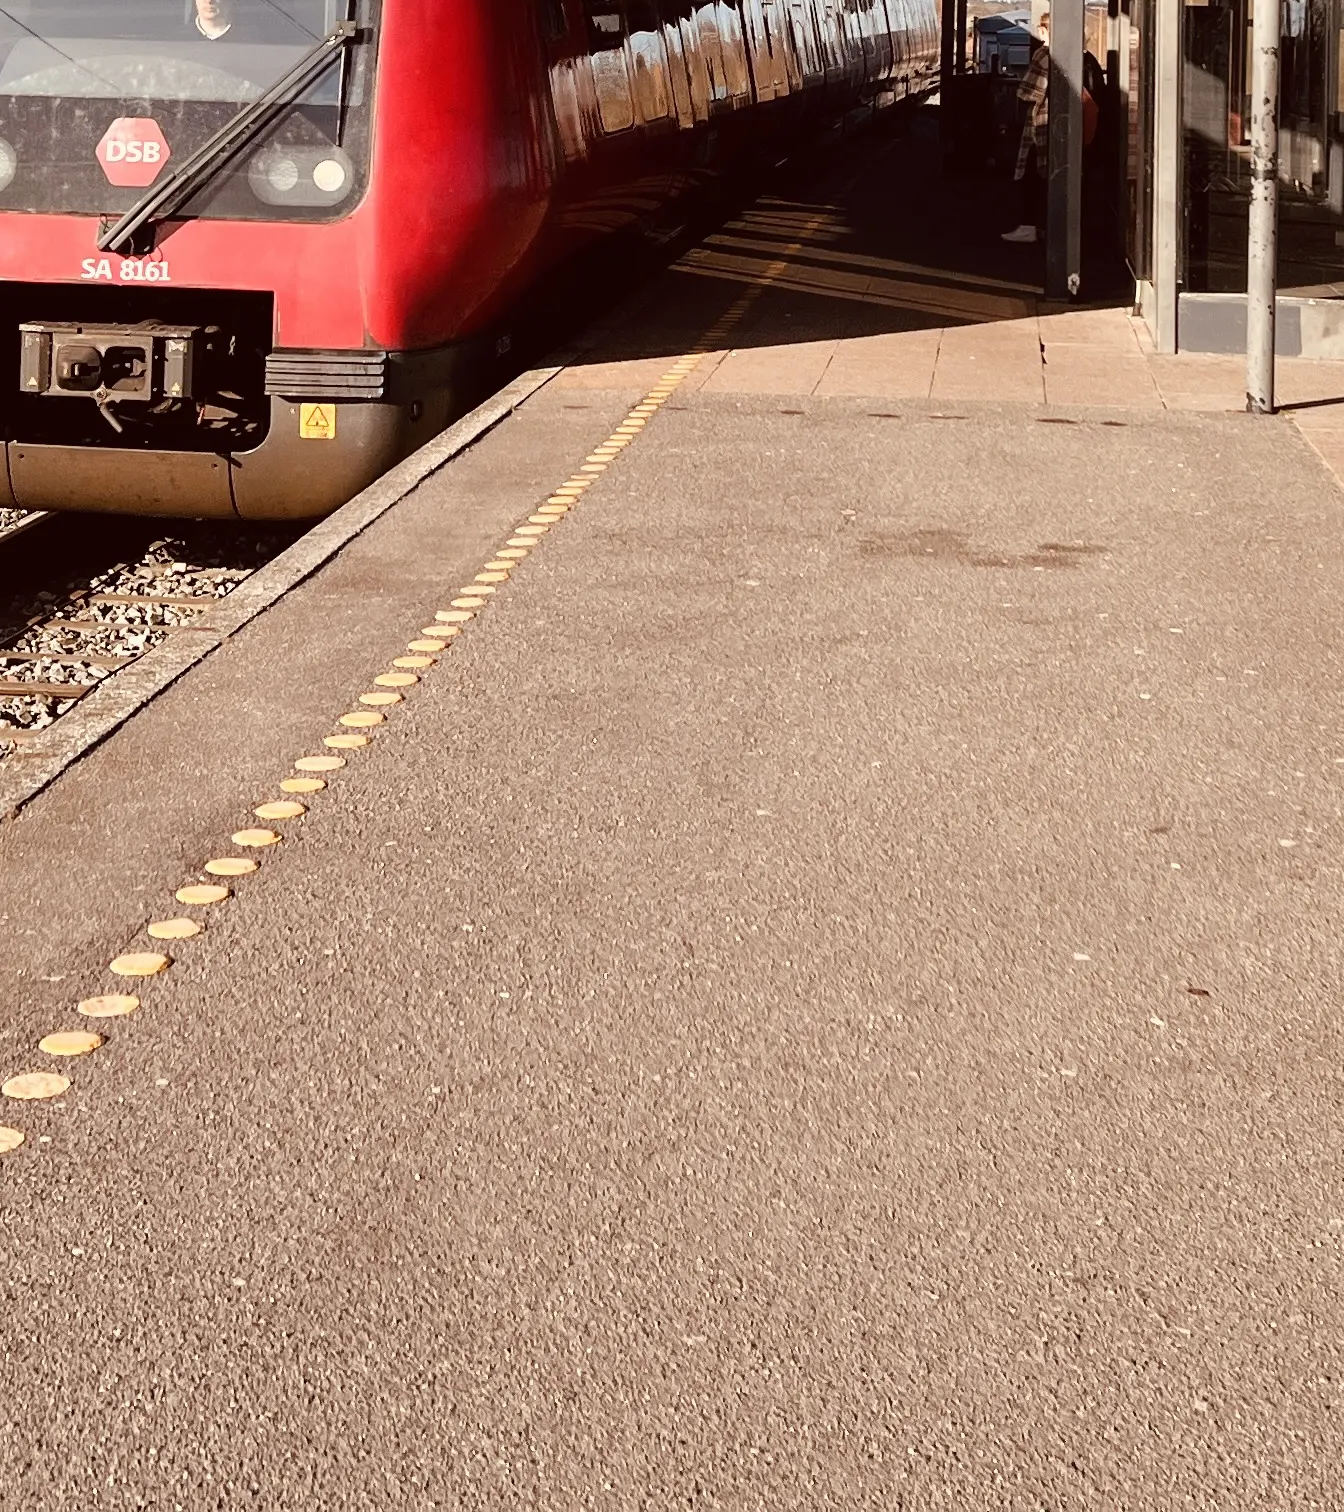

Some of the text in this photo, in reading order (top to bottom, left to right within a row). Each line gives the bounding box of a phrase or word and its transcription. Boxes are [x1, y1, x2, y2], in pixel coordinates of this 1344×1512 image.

[105, 140, 161, 163] DSB
[80, 258, 171, 282] SA 8161
